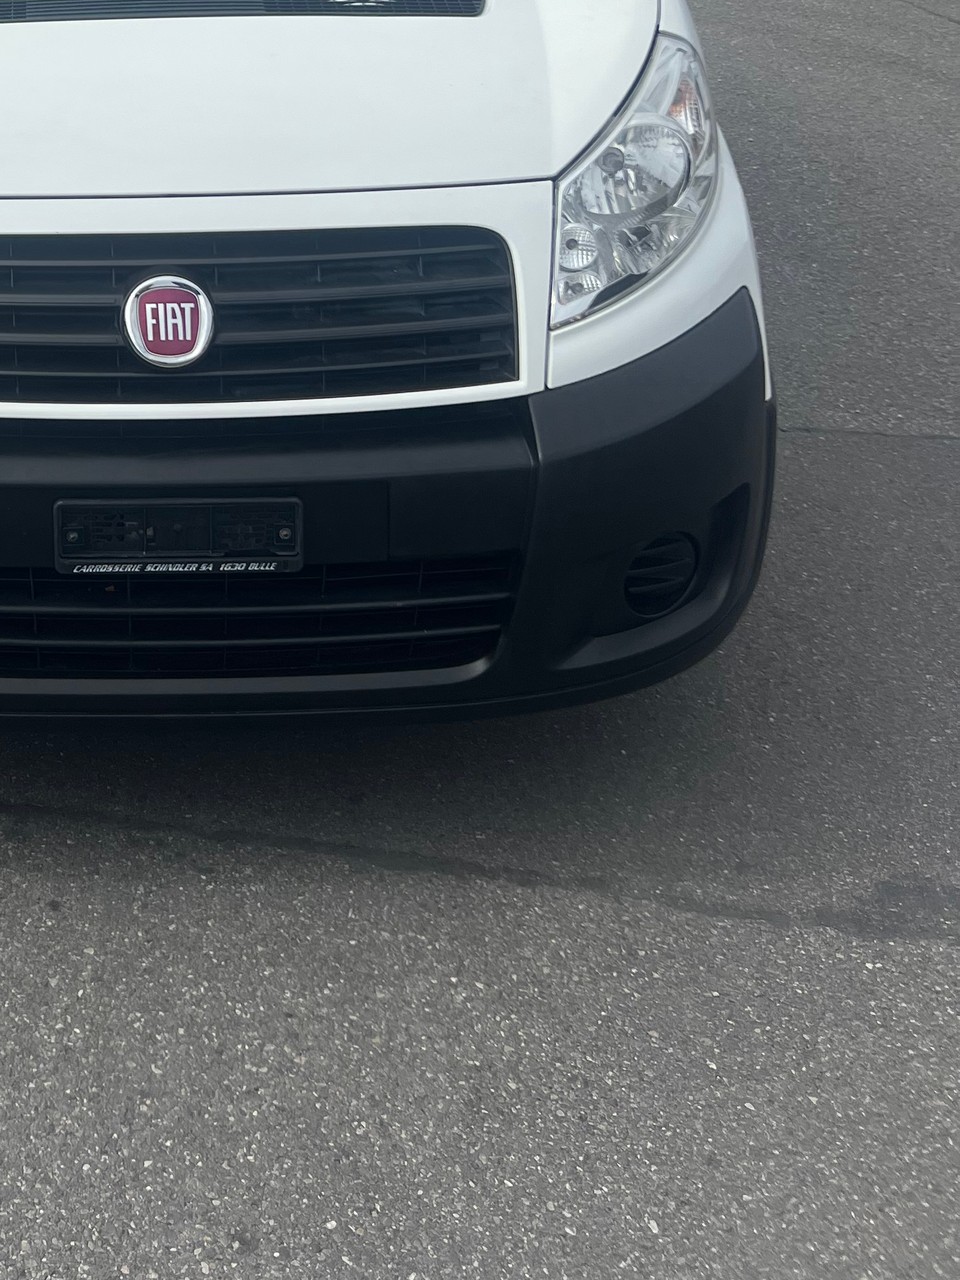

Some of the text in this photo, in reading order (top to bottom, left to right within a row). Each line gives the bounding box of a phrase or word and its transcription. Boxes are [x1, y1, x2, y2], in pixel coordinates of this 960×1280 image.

[145, 302, 195, 342] FIAT
[73, 562, 278, 573] CARROSSERIE SCHINDLER SA 1630 BULLE
